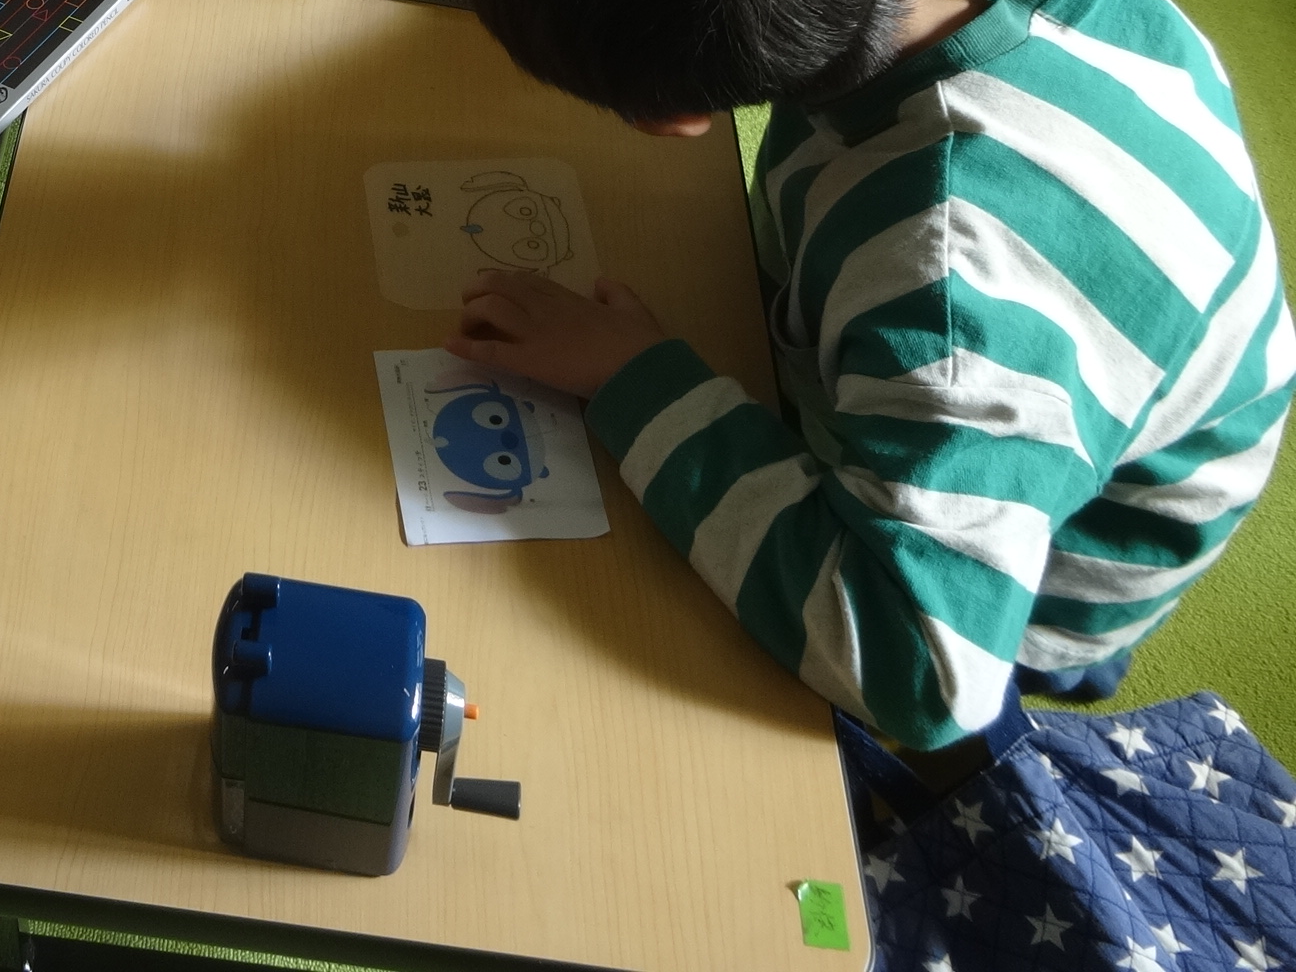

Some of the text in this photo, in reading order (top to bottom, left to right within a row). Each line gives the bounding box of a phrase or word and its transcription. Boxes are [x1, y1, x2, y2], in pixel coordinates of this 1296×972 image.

[26, 8, 120, 102] SAKURA COUPY COLORED PENCIL
[388, 183, 412, 216] 新山
[418, 480, 426, 490] 23
